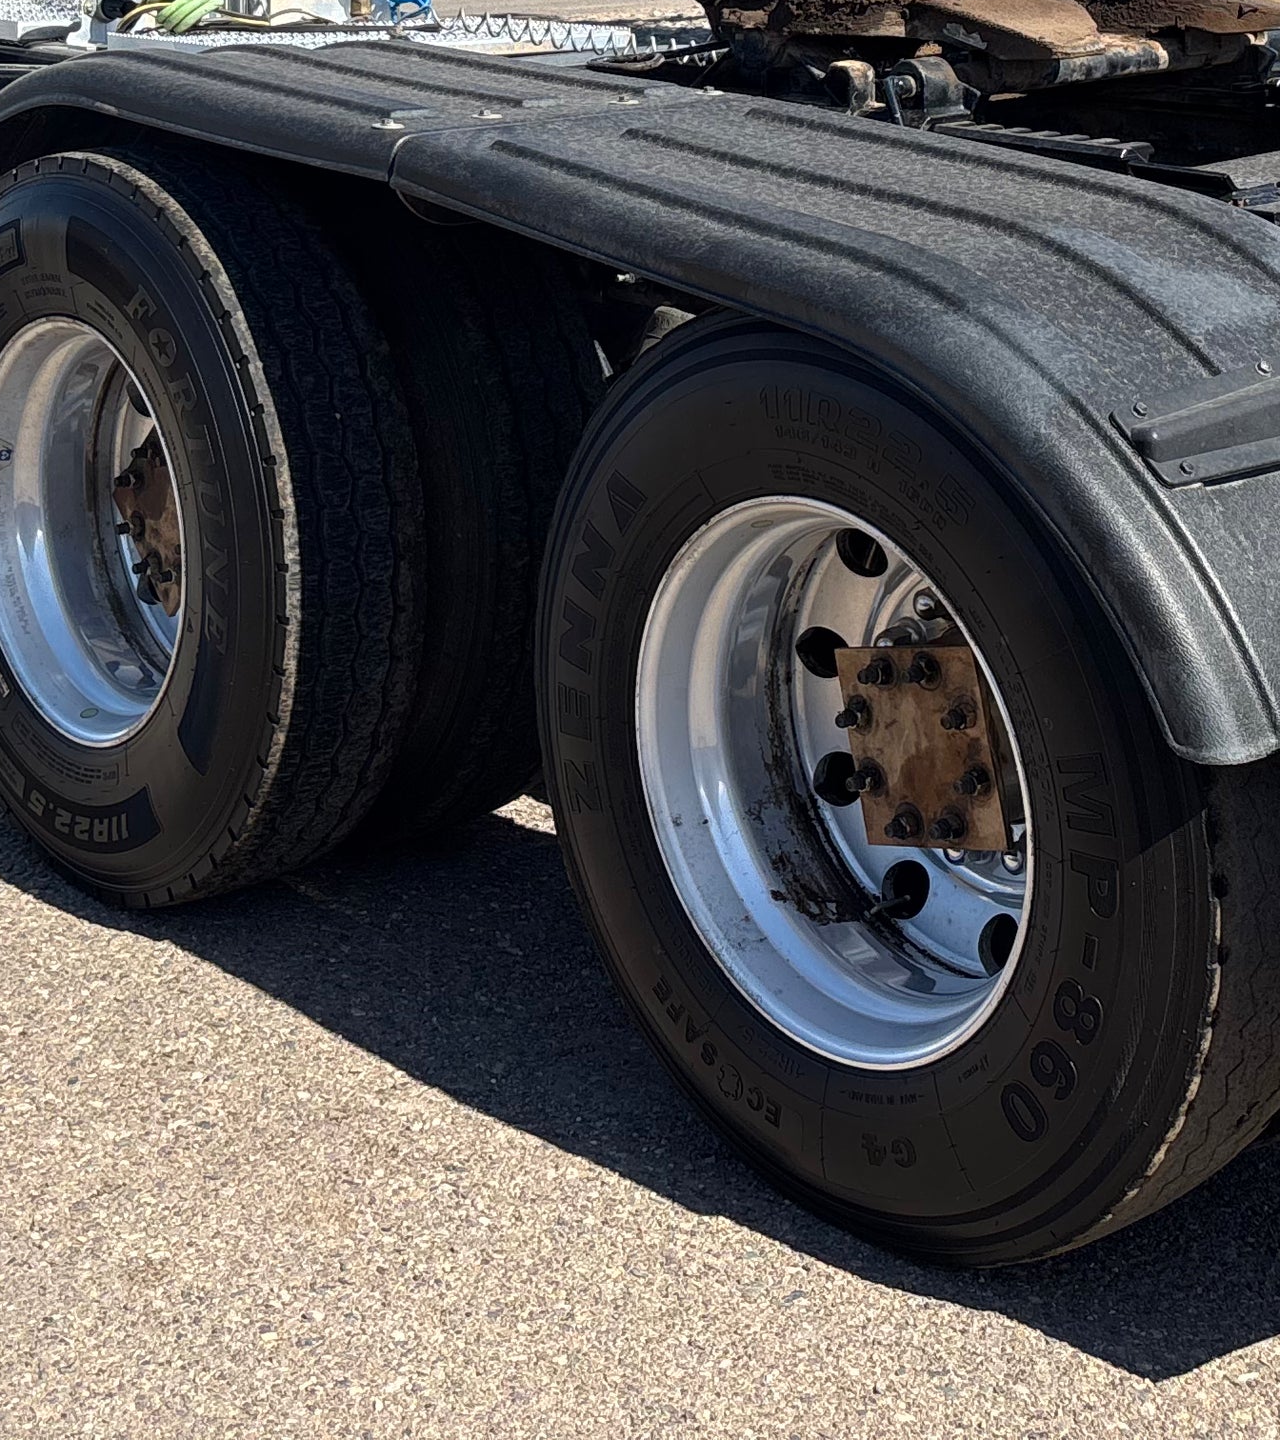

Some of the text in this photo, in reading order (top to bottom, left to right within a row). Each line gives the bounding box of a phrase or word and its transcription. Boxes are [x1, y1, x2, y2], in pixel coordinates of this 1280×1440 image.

[123, 284, 230, 657] FORTUNE
[557, 469, 648, 814] ZENNA
[26, 788, 130, 843] 11R22.5
[1000, 752, 1117, 1142] MP-860
[861, 1132, 917, 1168] G4
